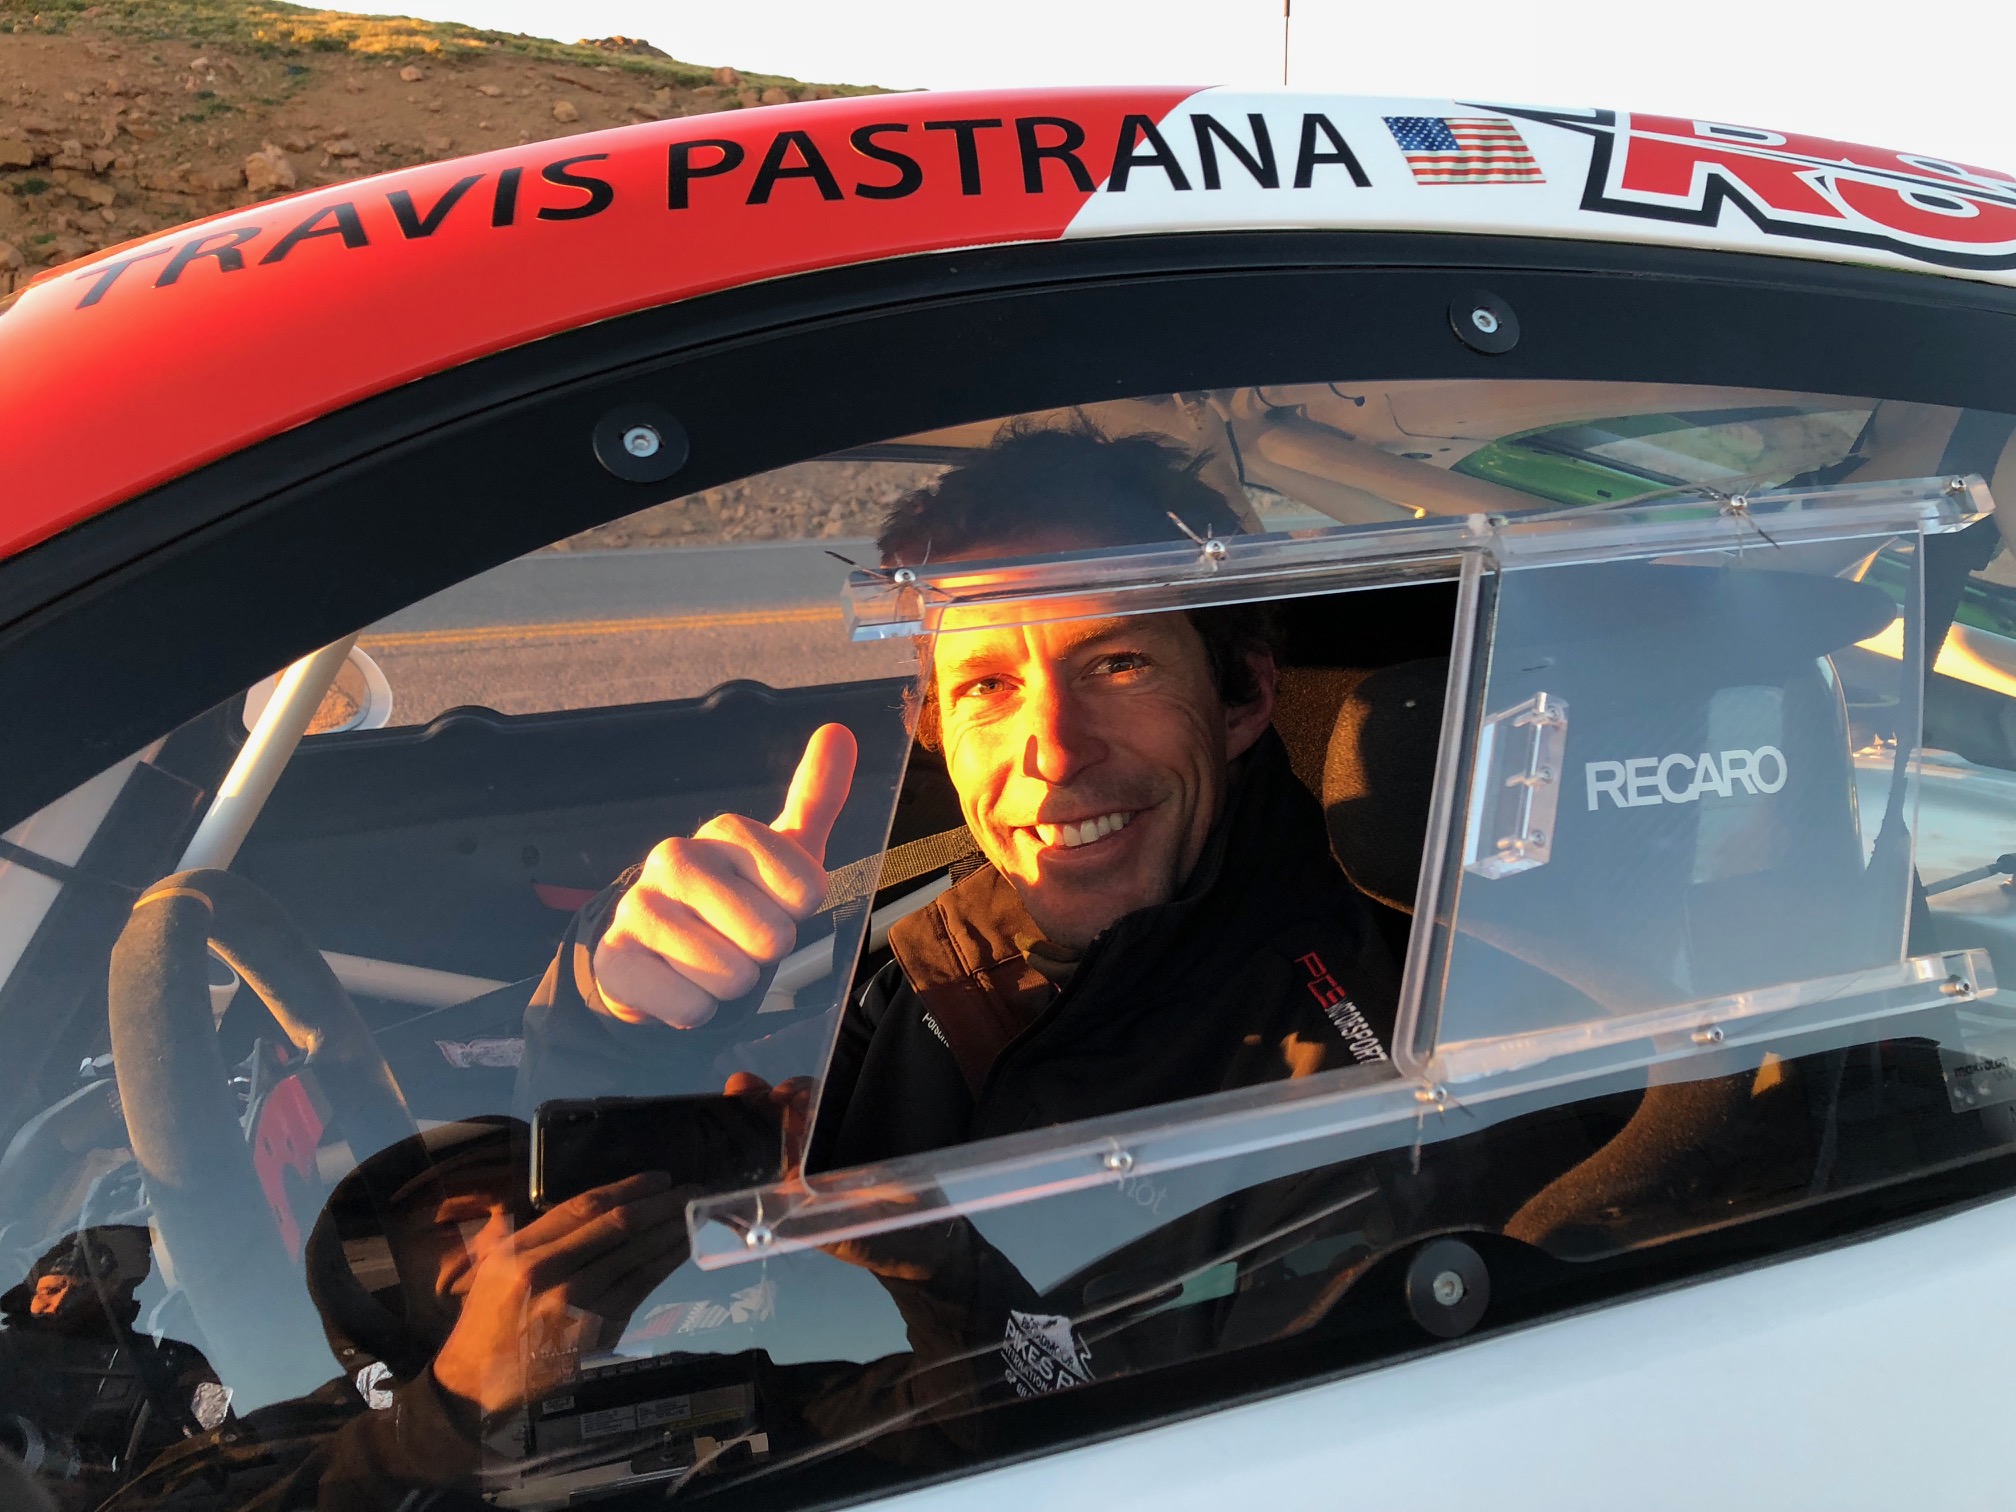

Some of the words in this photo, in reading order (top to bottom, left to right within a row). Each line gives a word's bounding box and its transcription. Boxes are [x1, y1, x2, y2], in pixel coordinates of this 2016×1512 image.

[75, 153, 615, 310] TRAVIS
[667, 113, 1373, 210] PASTRANA
[1585, 745, 1788, 812] RECARO
[1004, 1318, 1054, 1380] PIKES
[1056, 1369, 1082, 1390] P
